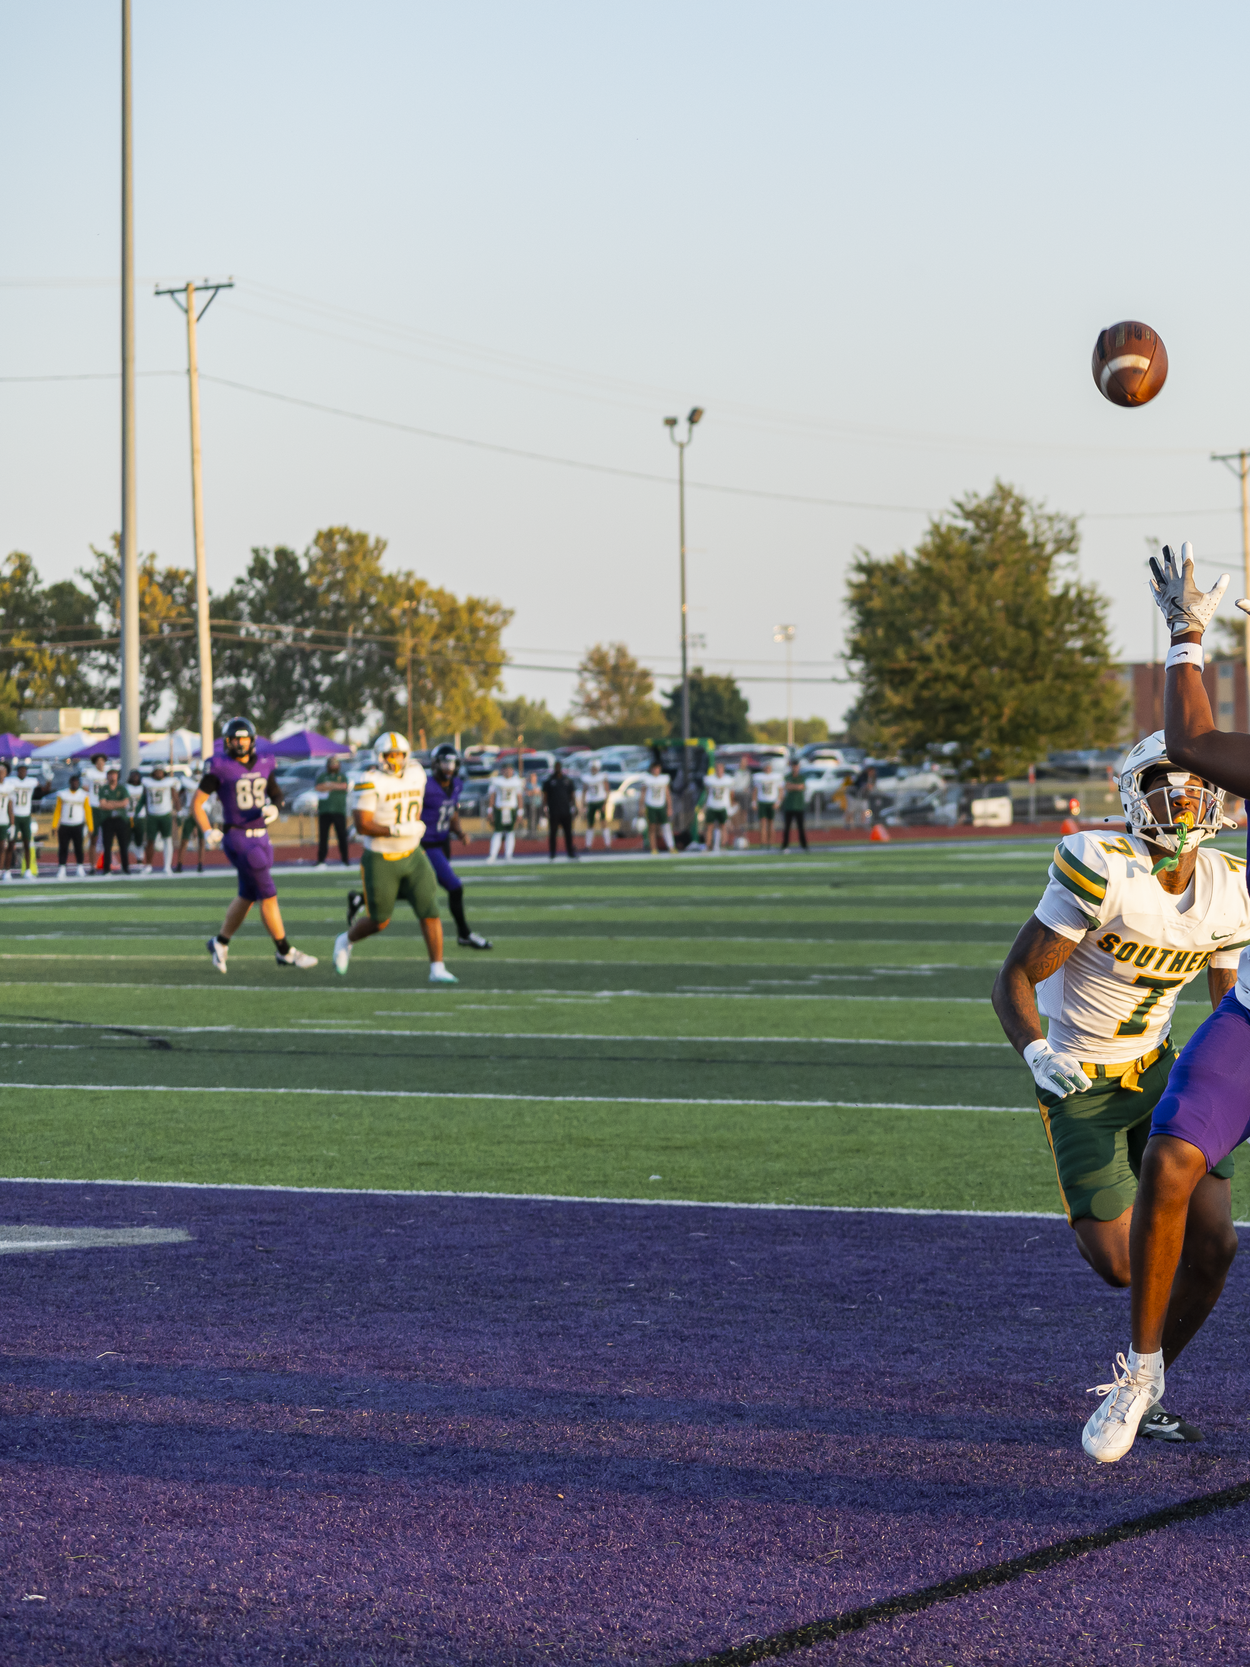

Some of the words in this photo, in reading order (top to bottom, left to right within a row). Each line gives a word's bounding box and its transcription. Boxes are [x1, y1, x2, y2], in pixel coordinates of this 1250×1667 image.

[236, 777, 268, 810] 89
[393, 801, 420, 826] 10
[1099, 837, 1136, 858] 7
[1113, 972, 1188, 1039] 7
